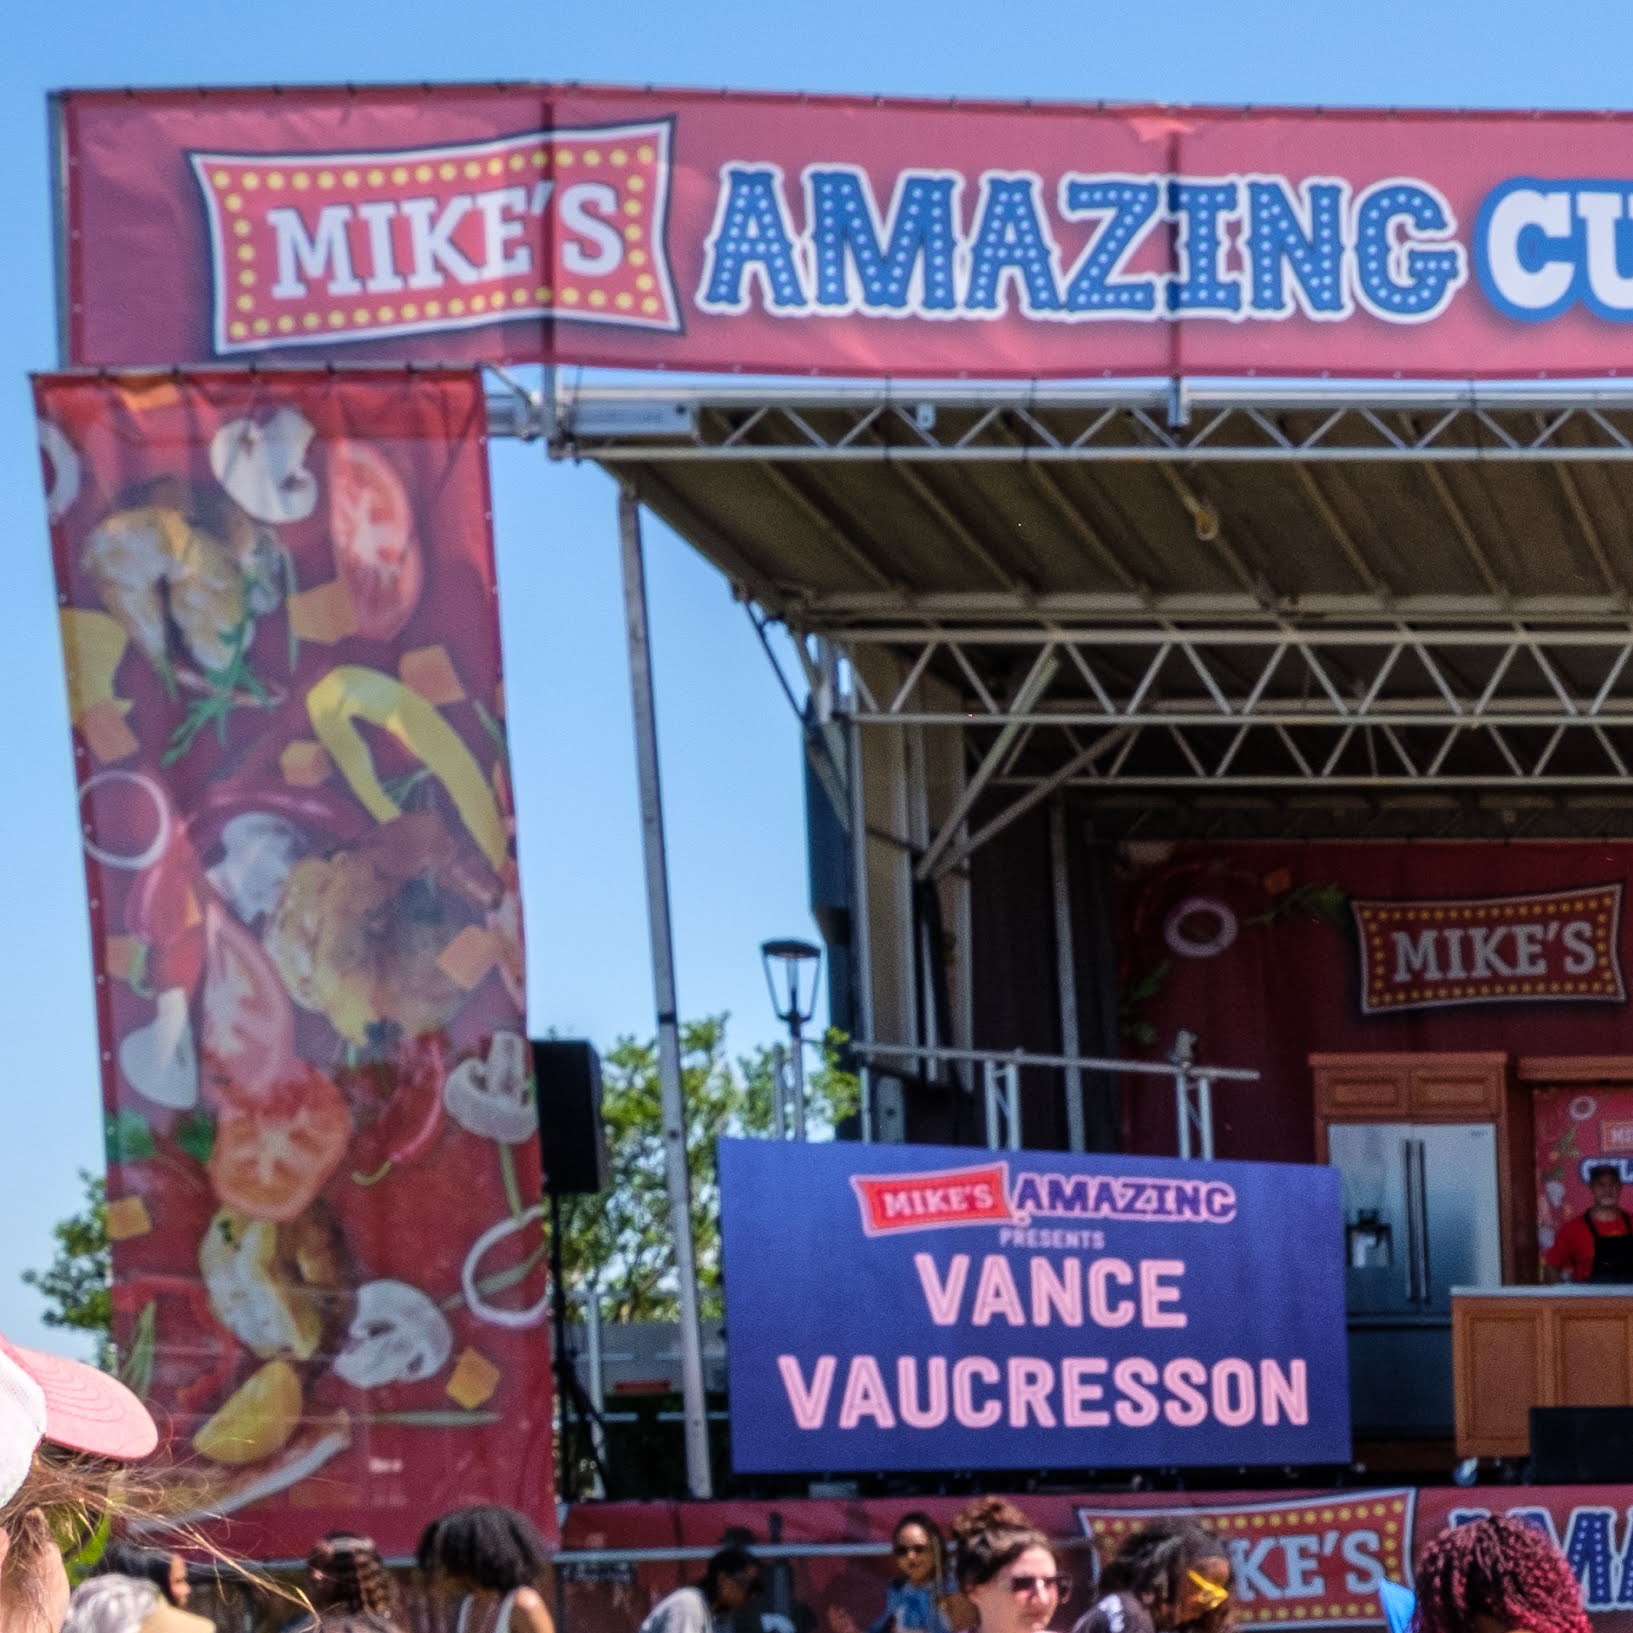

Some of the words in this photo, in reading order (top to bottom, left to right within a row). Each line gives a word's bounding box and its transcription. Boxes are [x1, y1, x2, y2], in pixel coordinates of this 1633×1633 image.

[266, 181, 623, 302] MIKE'S
[698, 164, 1467, 323] AMAZING
[1391, 921, 1595, 982] MIKE'S
[881, 1182, 995, 1218] MIKE'S
[1011, 1172, 1237, 1224] AMAZING
[999, 1227, 1105, 1250] PRESENTS
[914, 1252, 1188, 1329] VANCE
[778, 1354, 1309, 1431] VAUCRESSON
[1228, 1529, 1387, 1602] KE'S
